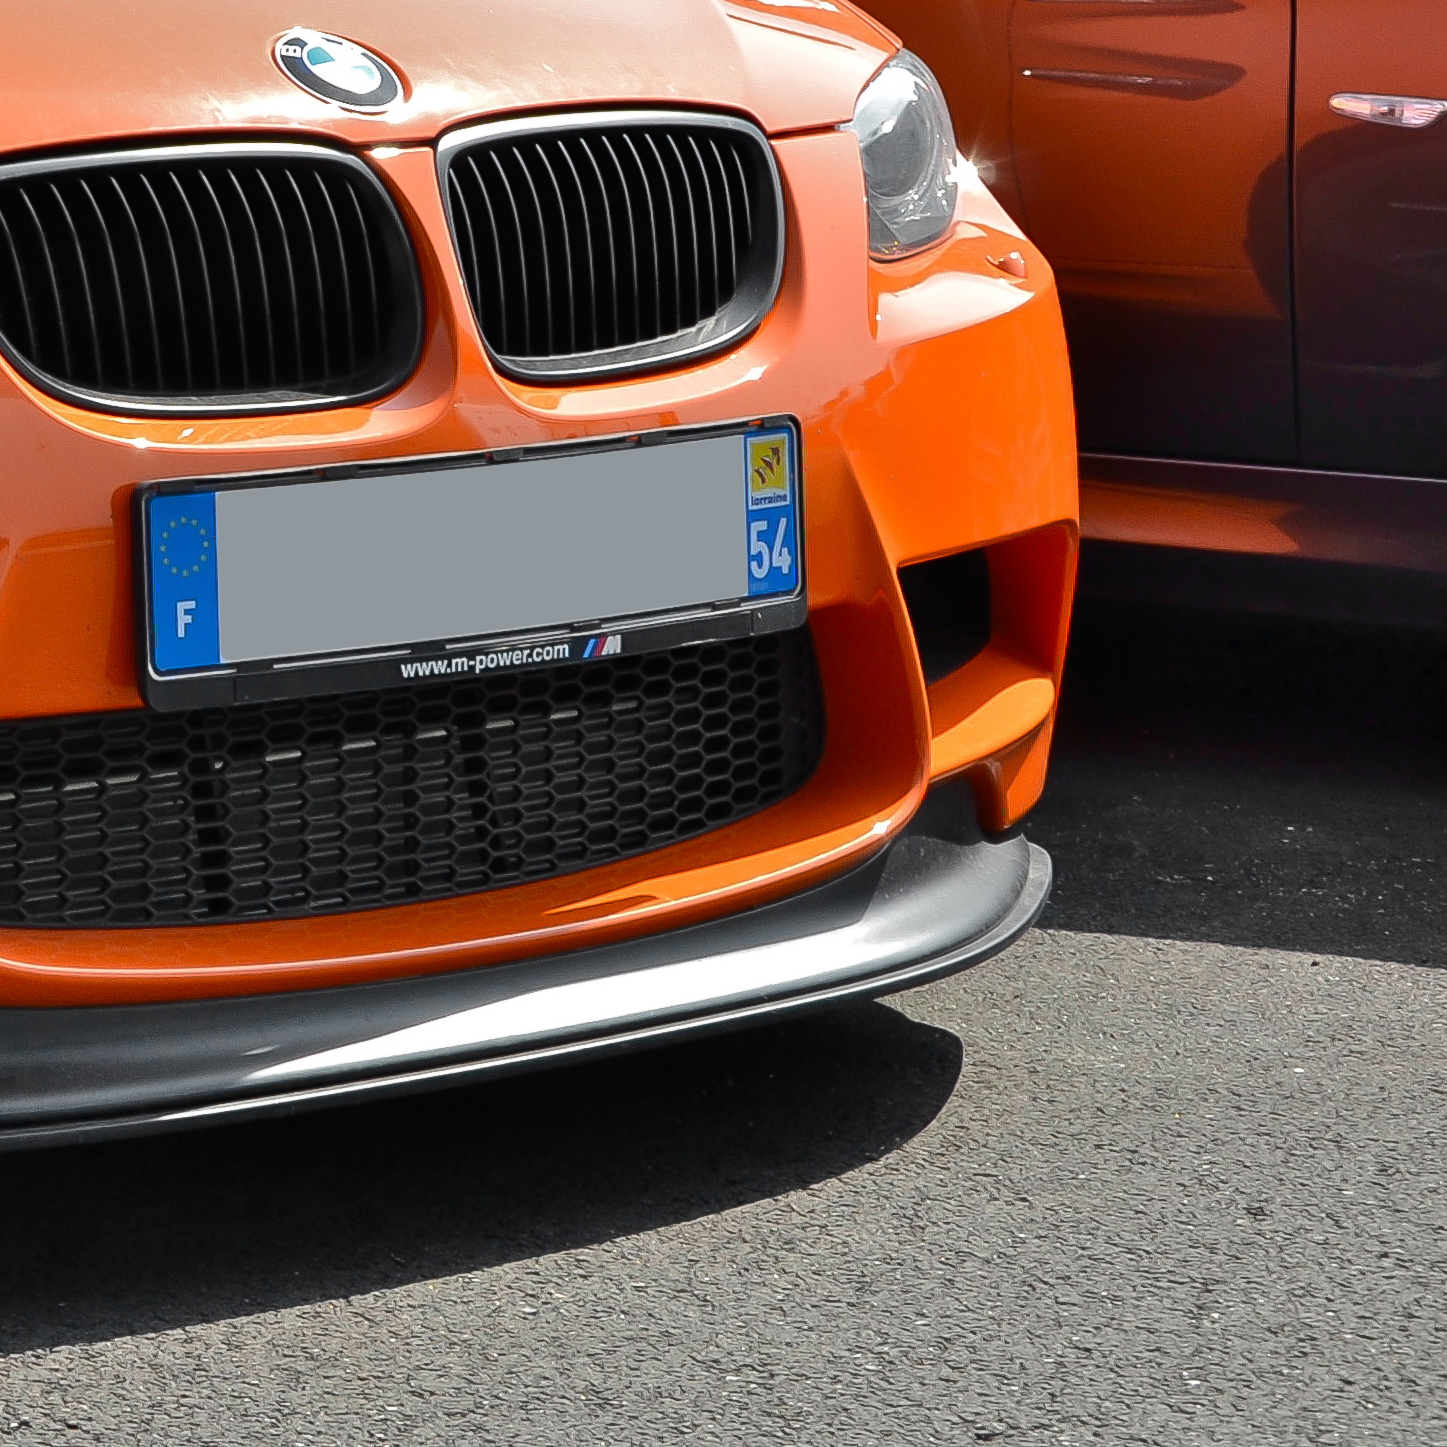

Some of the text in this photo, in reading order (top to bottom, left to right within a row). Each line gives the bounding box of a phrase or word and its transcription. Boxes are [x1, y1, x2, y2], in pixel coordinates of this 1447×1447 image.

[749, 516, 792, 580] 54
[176, 599, 197, 639] F
[400, 642, 570, 679] www.m-power.com
